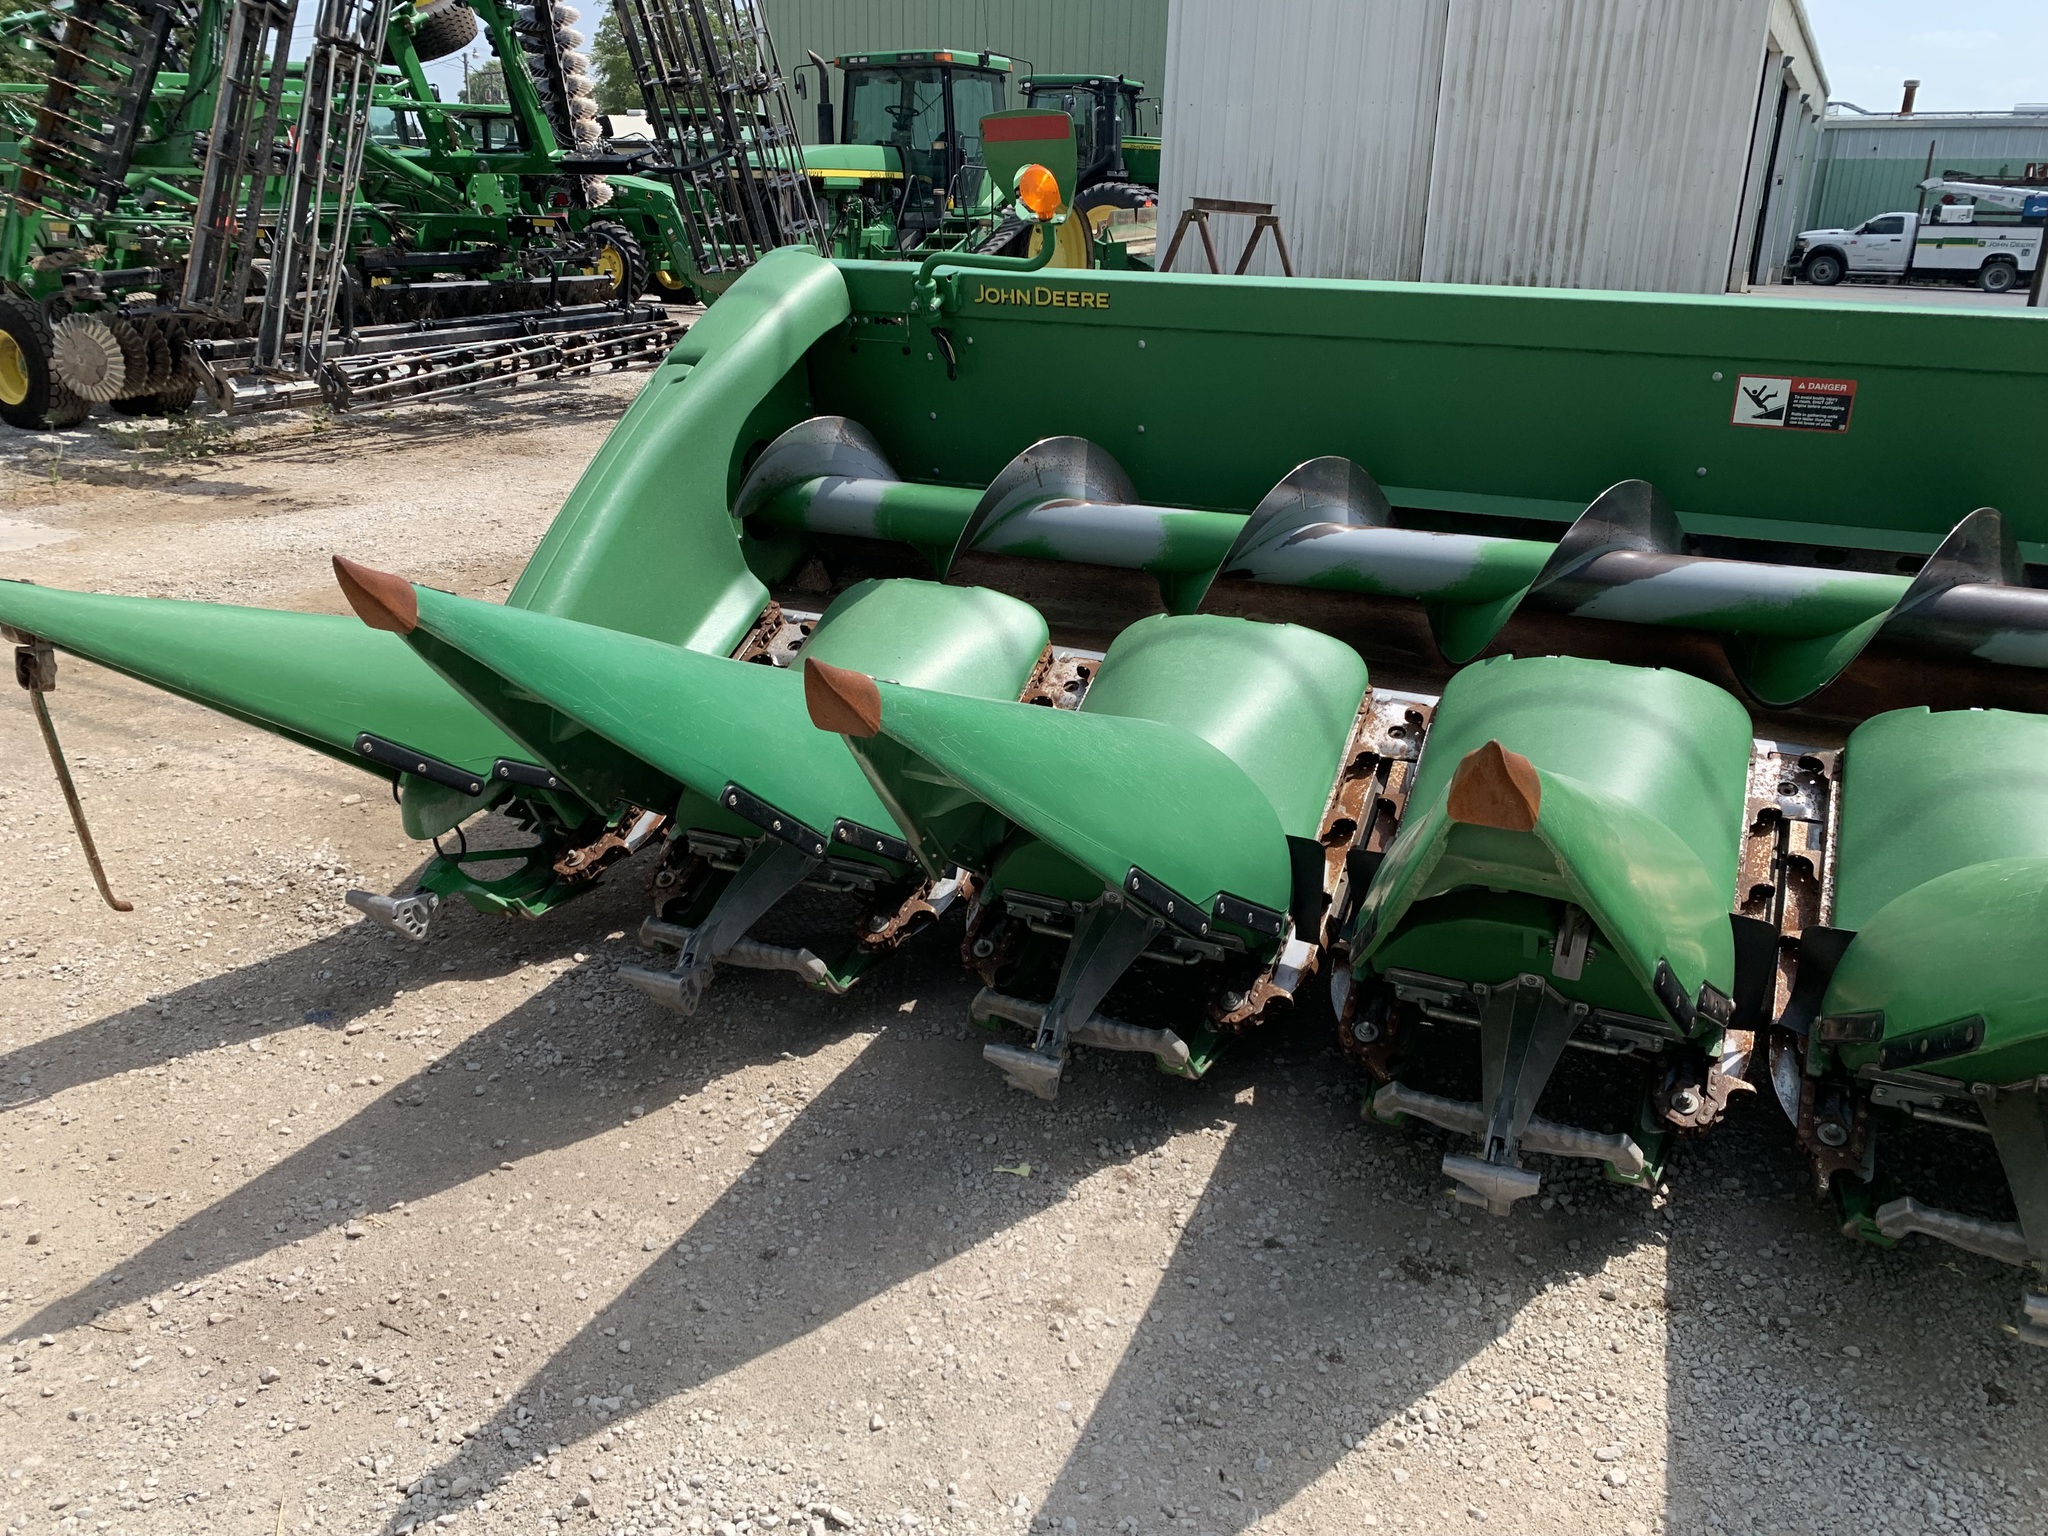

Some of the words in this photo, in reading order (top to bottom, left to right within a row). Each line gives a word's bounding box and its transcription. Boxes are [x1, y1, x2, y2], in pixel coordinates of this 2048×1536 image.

[974, 284, 1031, 306] JOHN
[1034, 286, 1110, 309] DEERE
[1808, 382, 1847, 391] DANGER
